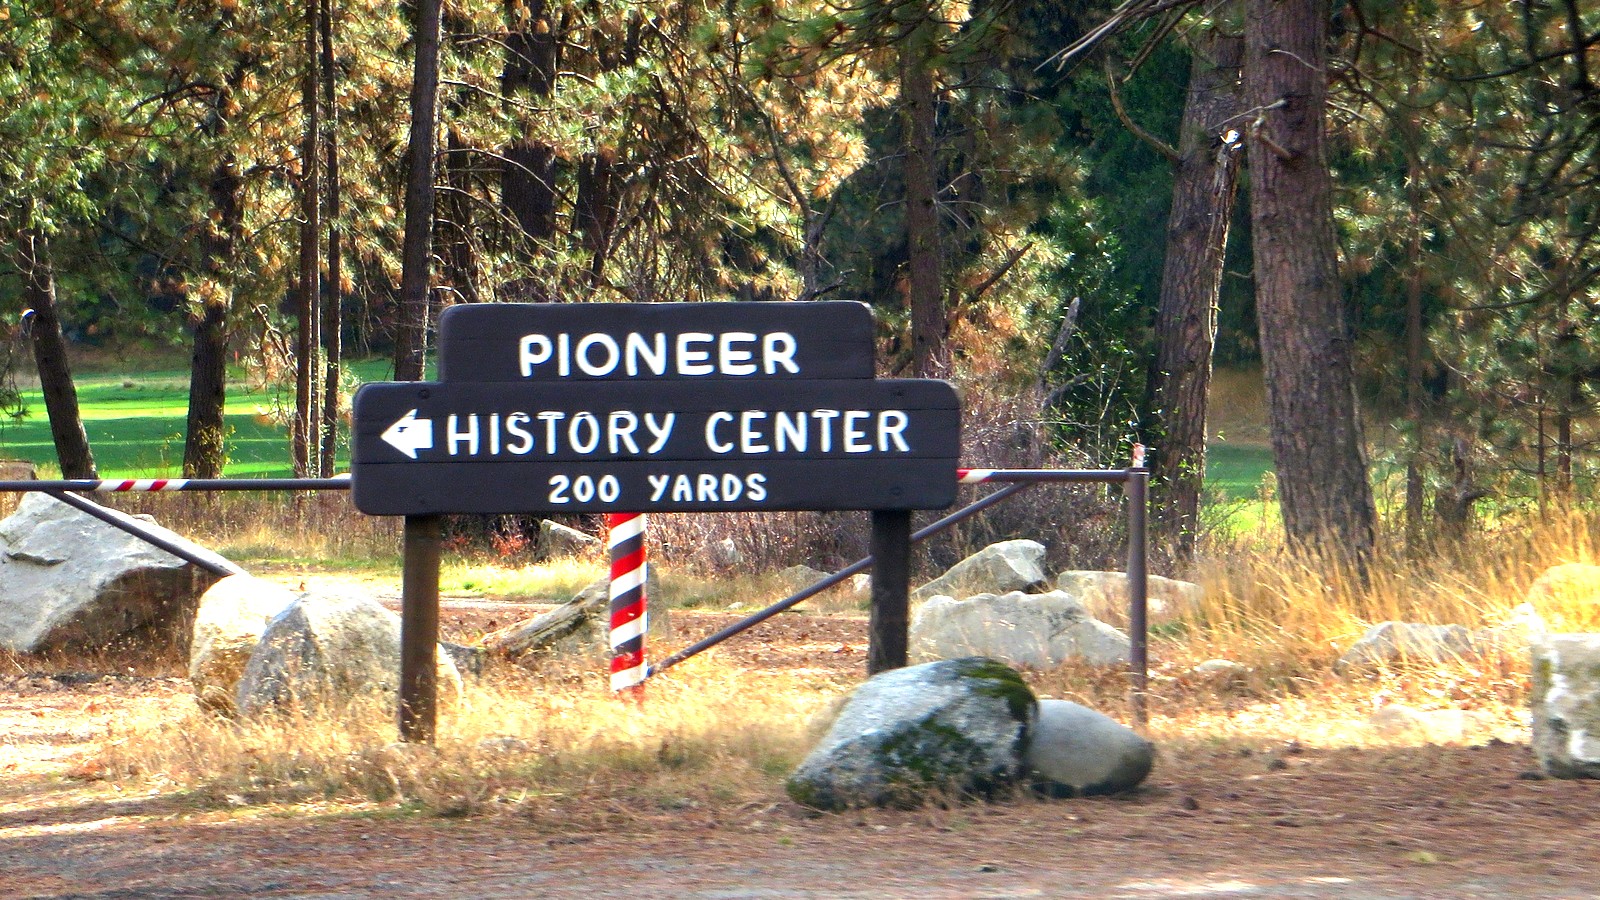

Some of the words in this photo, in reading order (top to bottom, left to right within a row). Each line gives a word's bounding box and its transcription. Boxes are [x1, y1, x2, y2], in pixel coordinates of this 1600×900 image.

[519, 332, 799, 377] PIONEER
[447, 410, 675, 456] HISTORY
[705, 409, 910, 454] CENTER
[549, 474, 619, 504] 200
[648, 473, 766, 502] YARDS
